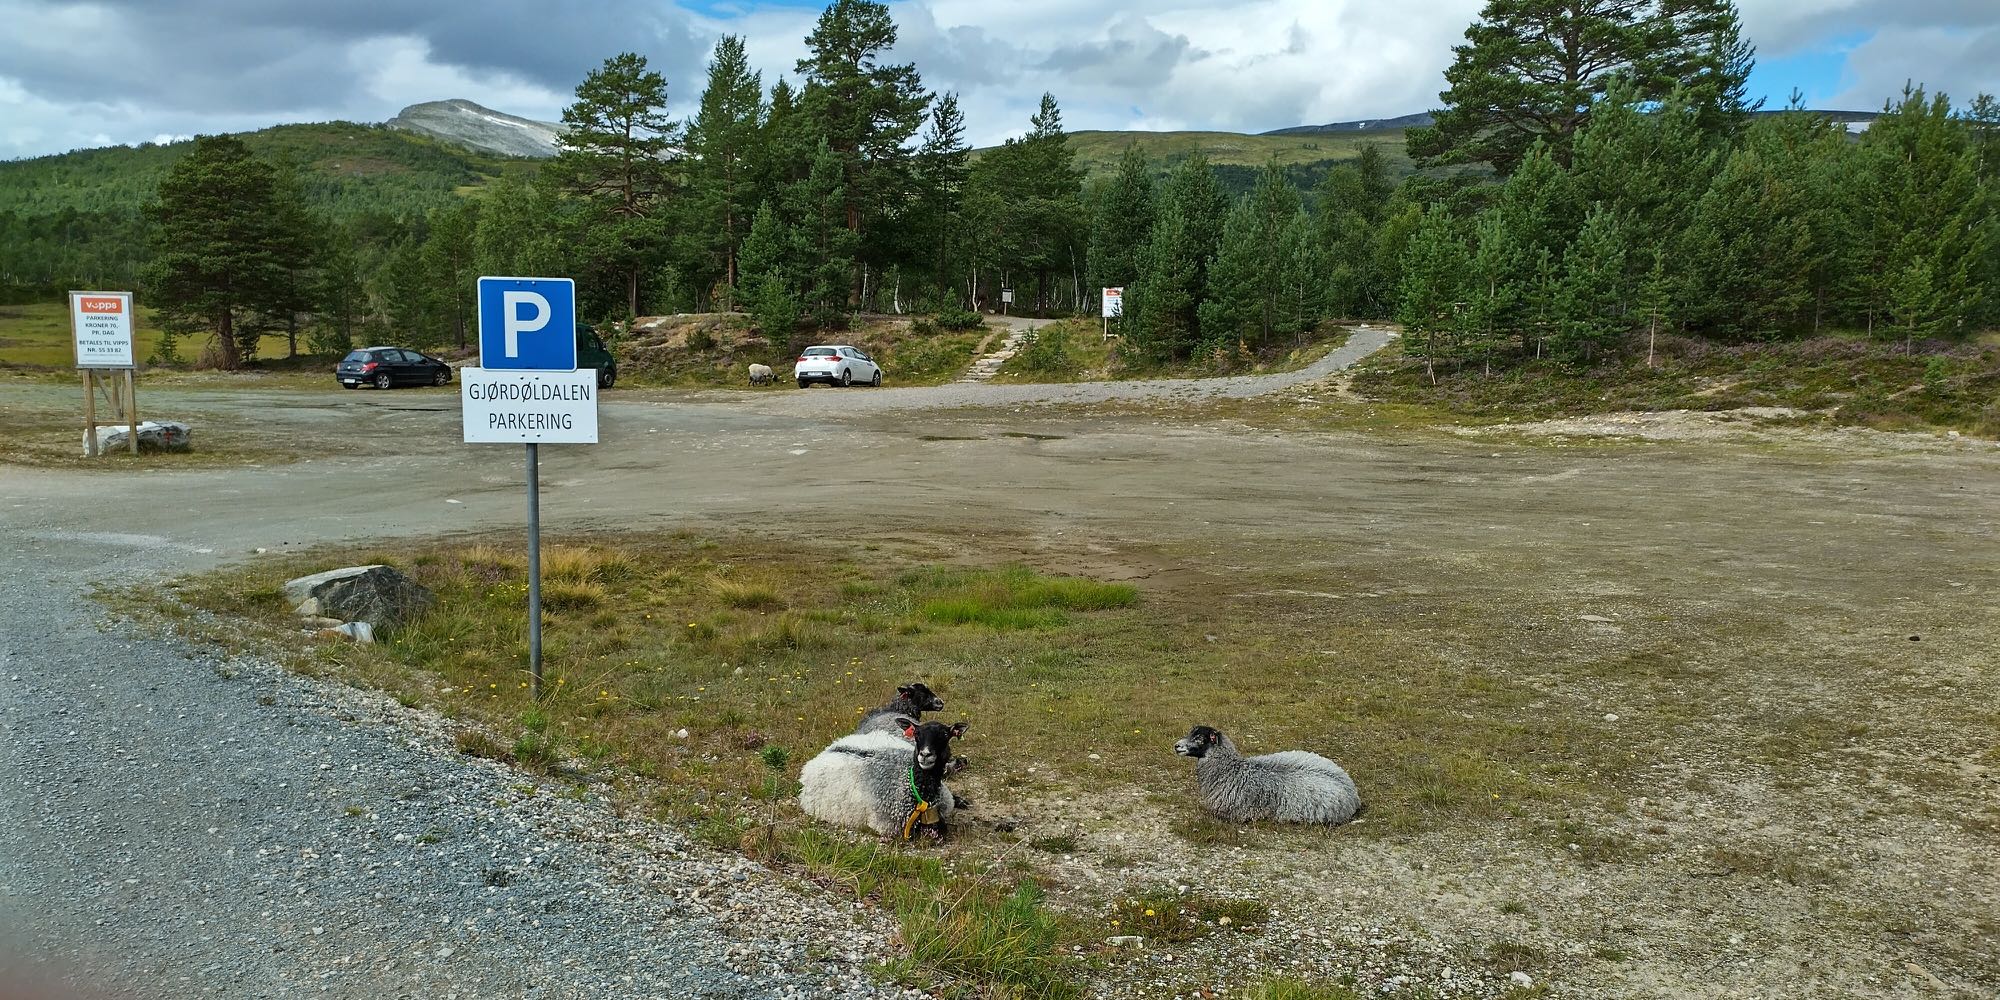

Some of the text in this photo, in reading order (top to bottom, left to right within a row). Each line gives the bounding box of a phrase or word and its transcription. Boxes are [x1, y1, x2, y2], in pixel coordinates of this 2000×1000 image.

[503, 290, 552, 358] P
[469, 381, 590, 402] GJØRDØLDALEN
[489, 413, 572, 430] PARKERING
